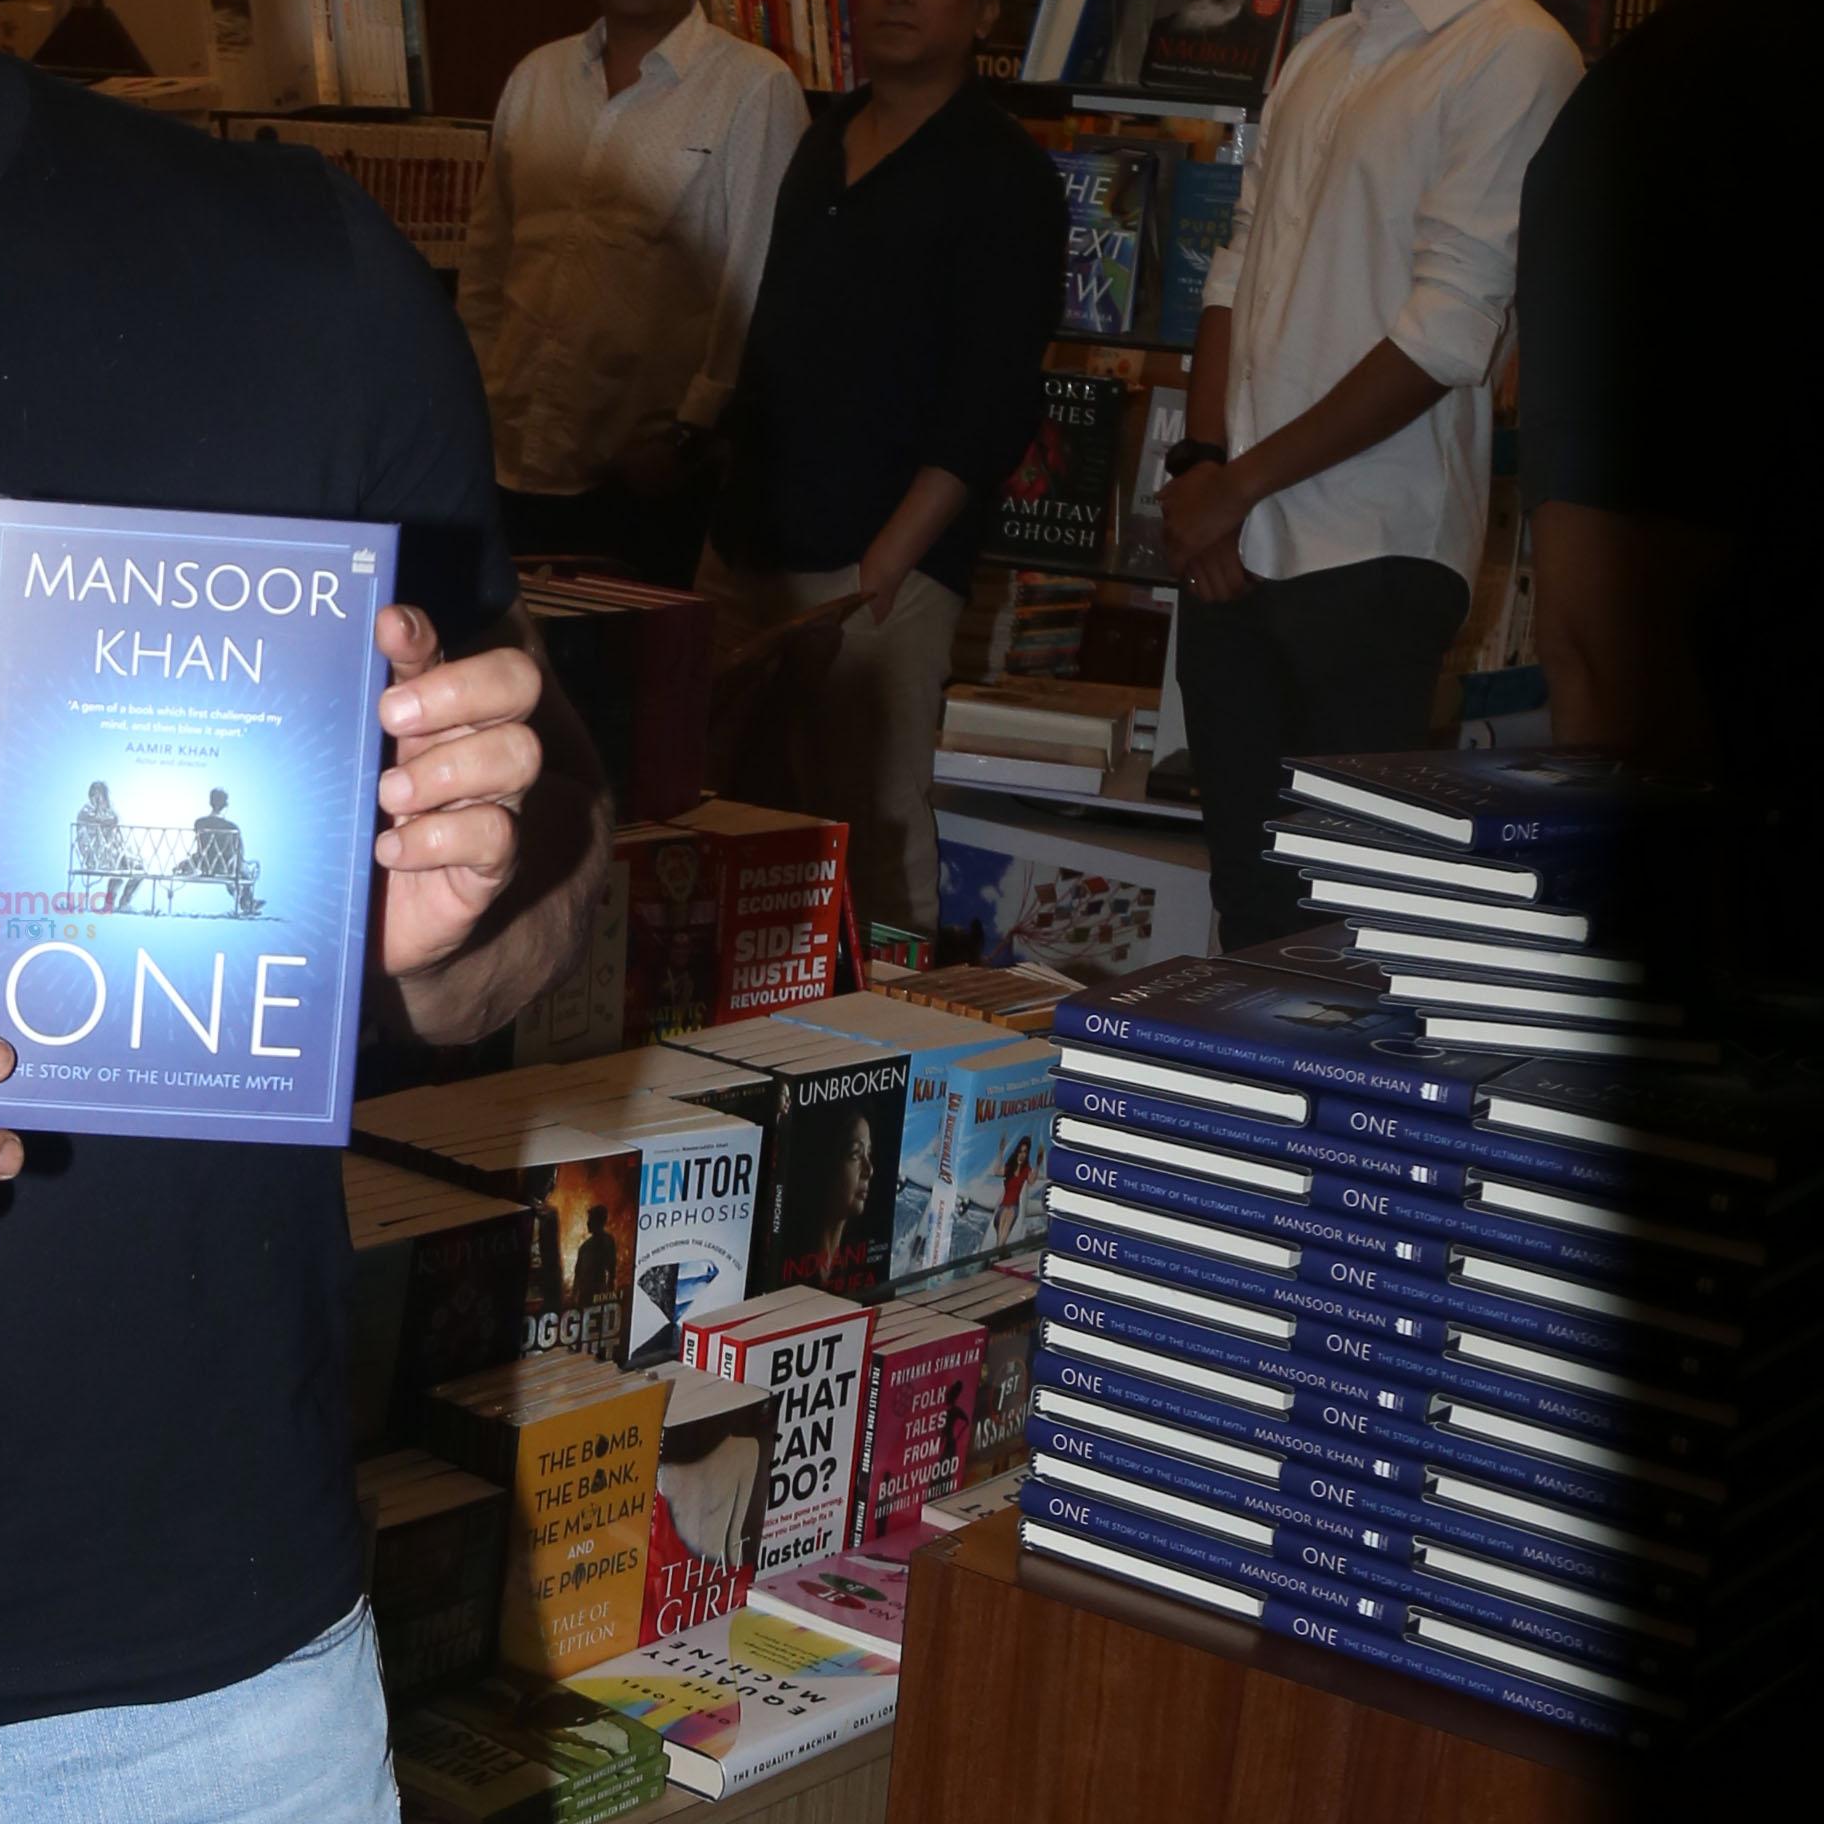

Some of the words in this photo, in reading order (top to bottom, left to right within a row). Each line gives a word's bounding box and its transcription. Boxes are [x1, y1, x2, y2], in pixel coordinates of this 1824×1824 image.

[1000, 496, 1103, 523] AMITAV
[1001, 518, 1096, 549] GHOSH
[24, 551, 346, 619] MANSOOR
[94, 628, 264, 684] KHAN
[82, 703, 105, 714] gem
[106, 702, 119, 713] of
[129, 703, 154, 716] book
[157, 705, 186, 717] which
[188, 707, 208, 720] first
[210, 709, 265, 724] challenged
[267, 715, 282, 727] my
[132, 721, 151, 732] and
[152, 722, 176, 733] then
[178, 723, 202, 735] blew
[204, 724, 212, 735] it
[125, 742, 173, 755] AAMIR
[178, 744, 219, 758] KHAN
[1502, 822, 1540, 841] ONE
[738, 859, 837, 890] PASSION
[736, 886, 834, 915] ECONOMY
[733, 922, 829, 962] SIDE-
[730, 957, 827, 988] HUSTLE
[5, 941, 307, 1058] ONE
[729, 983, 826, 1010] REVOLUTION
[39, 1063, 93, 1084] STORY
[97, 1066, 122, 1084] OF
[126, 1068, 159, 1085] THE
[163, 1070, 240, 1089] ULTIMATE
[244, 1073, 294, 1091] MYTH
[798, 1064, 907, 1107] UNBROKEN
[769, 1332, 844, 1387] BUT
[911, 1385, 947, 1414] FOLK
[904, 1410, 948, 1440] TALES
[538, 1444, 578, 1477] THE
[580, 1425, 644, 1464] BOMB,
[902, 1437, 940, 1467] FROM
[767, 1457, 838, 1511] DO?
[877, 1456, 960, 1501] BOLLYWOOD
[534, 1481, 574, 1513] THE
[566, 1538, 595, 1561] AND
[559, 1547, 639, 1594] POPPIES
[660, 1536, 751, 1600] THAT
[551, 1610, 587, 1636] TALE
[589, 1600, 612, 1623] OF
[655, 1576, 742, 1639] GIRL
[640, 1648, 807, 1717] EQUALITY
[668, 1639, 828, 1706] MACHINE
